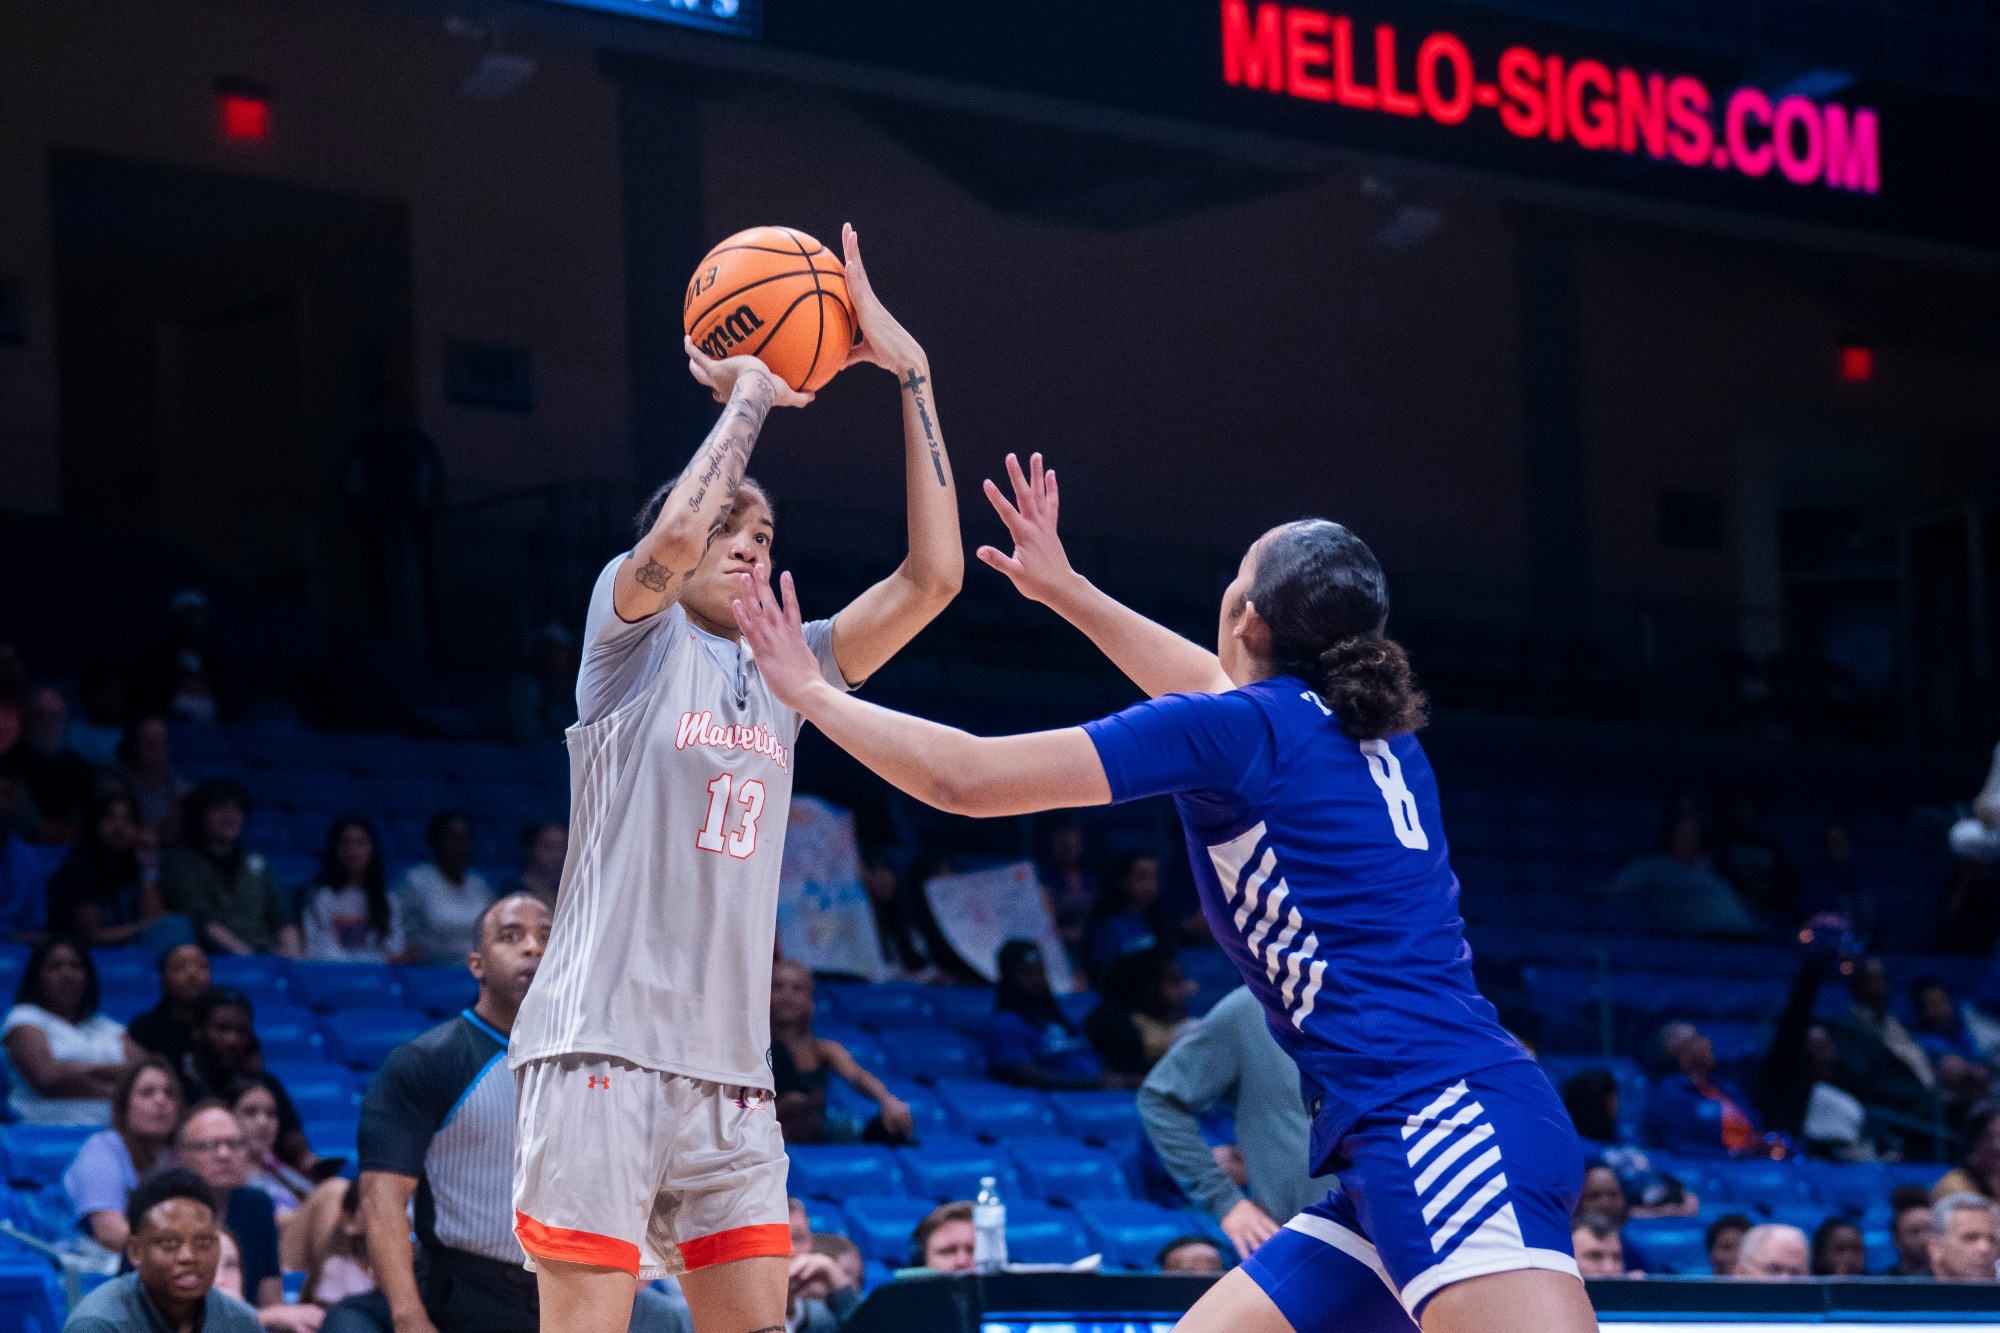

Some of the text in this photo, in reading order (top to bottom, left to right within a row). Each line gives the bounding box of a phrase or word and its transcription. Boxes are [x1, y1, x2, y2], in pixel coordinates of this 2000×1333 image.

[1220, 0, 1881, 194] MELLO-SIGNS.COM
[697, 304, 765, 359] Wils
[695, 772, 766, 860] 13
[1359, 738, 1429, 851] 8
